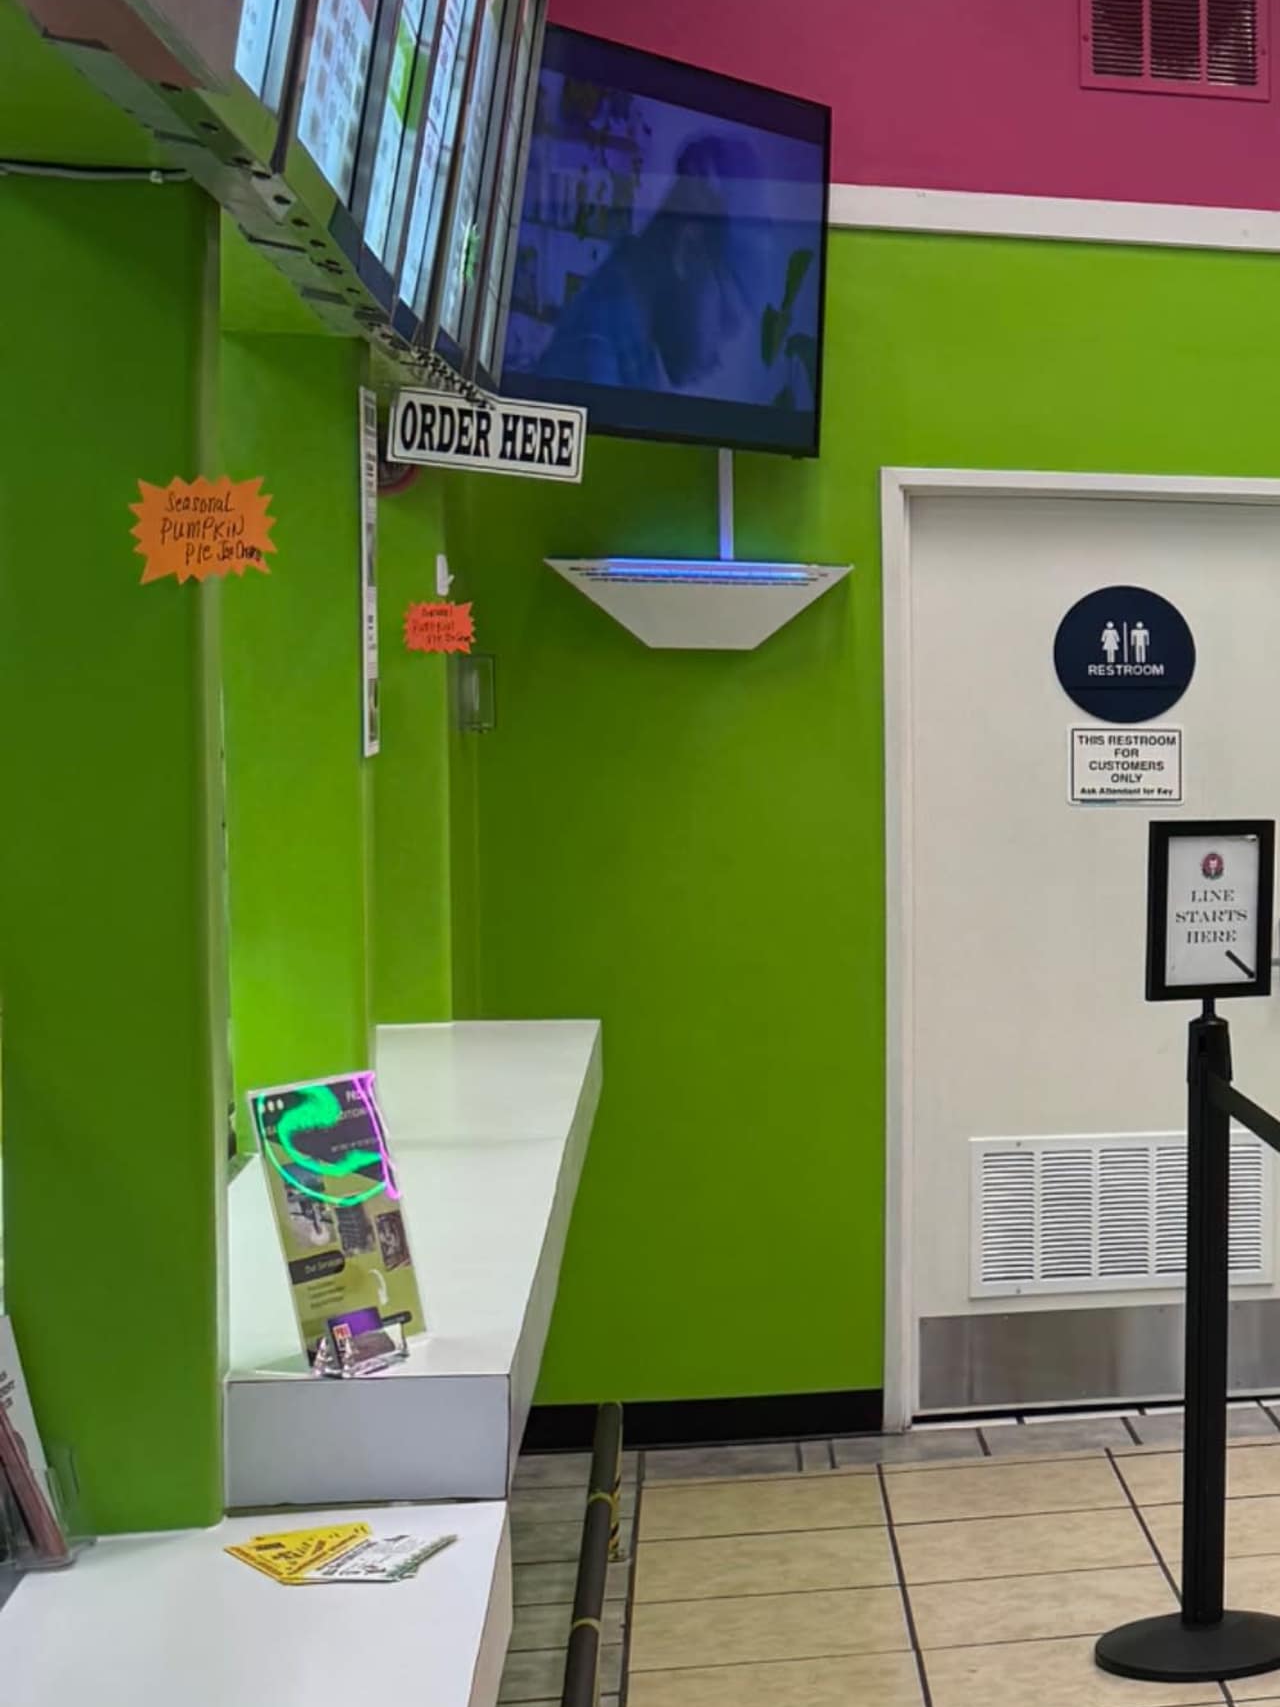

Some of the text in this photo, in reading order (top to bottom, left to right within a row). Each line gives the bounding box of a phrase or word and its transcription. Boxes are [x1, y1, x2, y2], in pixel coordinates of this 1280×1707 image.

[401, 400, 574, 467] ORDER HERE
[1087, 664, 1165, 676] RESTROOM
[1078, 735, 1177, 746] THIS RESTROOM
[1114, 748, 1139, 758] FOR
[1088, 760, 1165, 771] CUSTOMERS
[1110, 773, 1143, 783] ONLY
[1080, 787, 1097, 795] Ask
[1157, 787, 1173, 797] Key
[1191, 889, 1235, 902] LINE
[1175, 909, 1248, 923] STARTS
[1186, 929, 1237, 944] HERE
